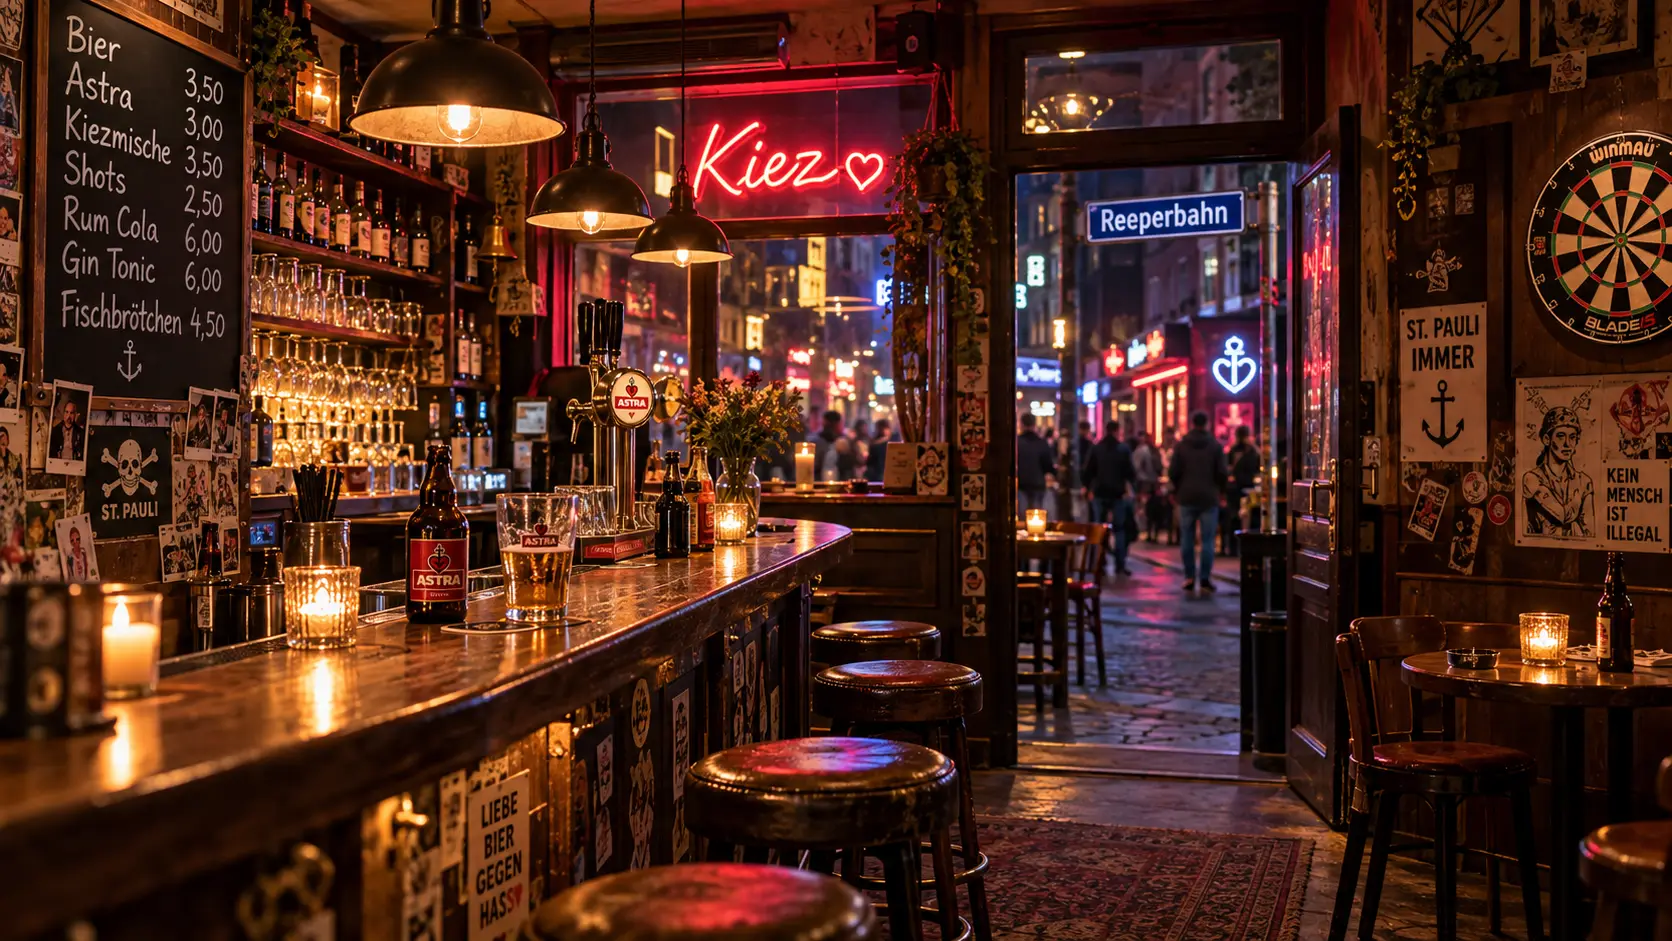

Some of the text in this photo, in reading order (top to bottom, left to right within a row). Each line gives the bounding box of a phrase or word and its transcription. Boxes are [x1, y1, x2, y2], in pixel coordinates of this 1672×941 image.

[66, 15, 224, 105] Bier 3,50
[65, 62, 223, 142] Astra 3,00
[65, 105, 223, 179] Kiezmische 3,50
[693, 120, 839, 198] Kiez
[64, 150, 223, 219] Shots 2,50
[64, 195, 223, 256] Rum Cola 6,00
[1101, 201, 1229, 236] Reeperbahn
[62, 240, 222, 293] Gin Tonic 6,00
[61, 289, 225, 342] Fischbrötchen 4,50
[1406, 314, 1480, 340] ST. PAULI
[1412, 344, 1475, 372] IMMER
[617, 398, 647, 408] ASTRA
[1606, 467, 1640, 484] KEIN
[101, 501, 158, 521] ST. PAULI
[1606, 487, 1663, 504] MENSCH
[1606, 505, 1628, 522] IST
[524, 536, 557, 547] ASTRA
[1606, 525, 1663, 543] ILLEGAL
[416, 574, 461, 586] ASTRA
[481, 791, 518, 828] LIEBE
[483, 823, 515, 860] BIER
[476, 850, 522, 895] GEGEN
[479, 886, 515, 930] HASS
